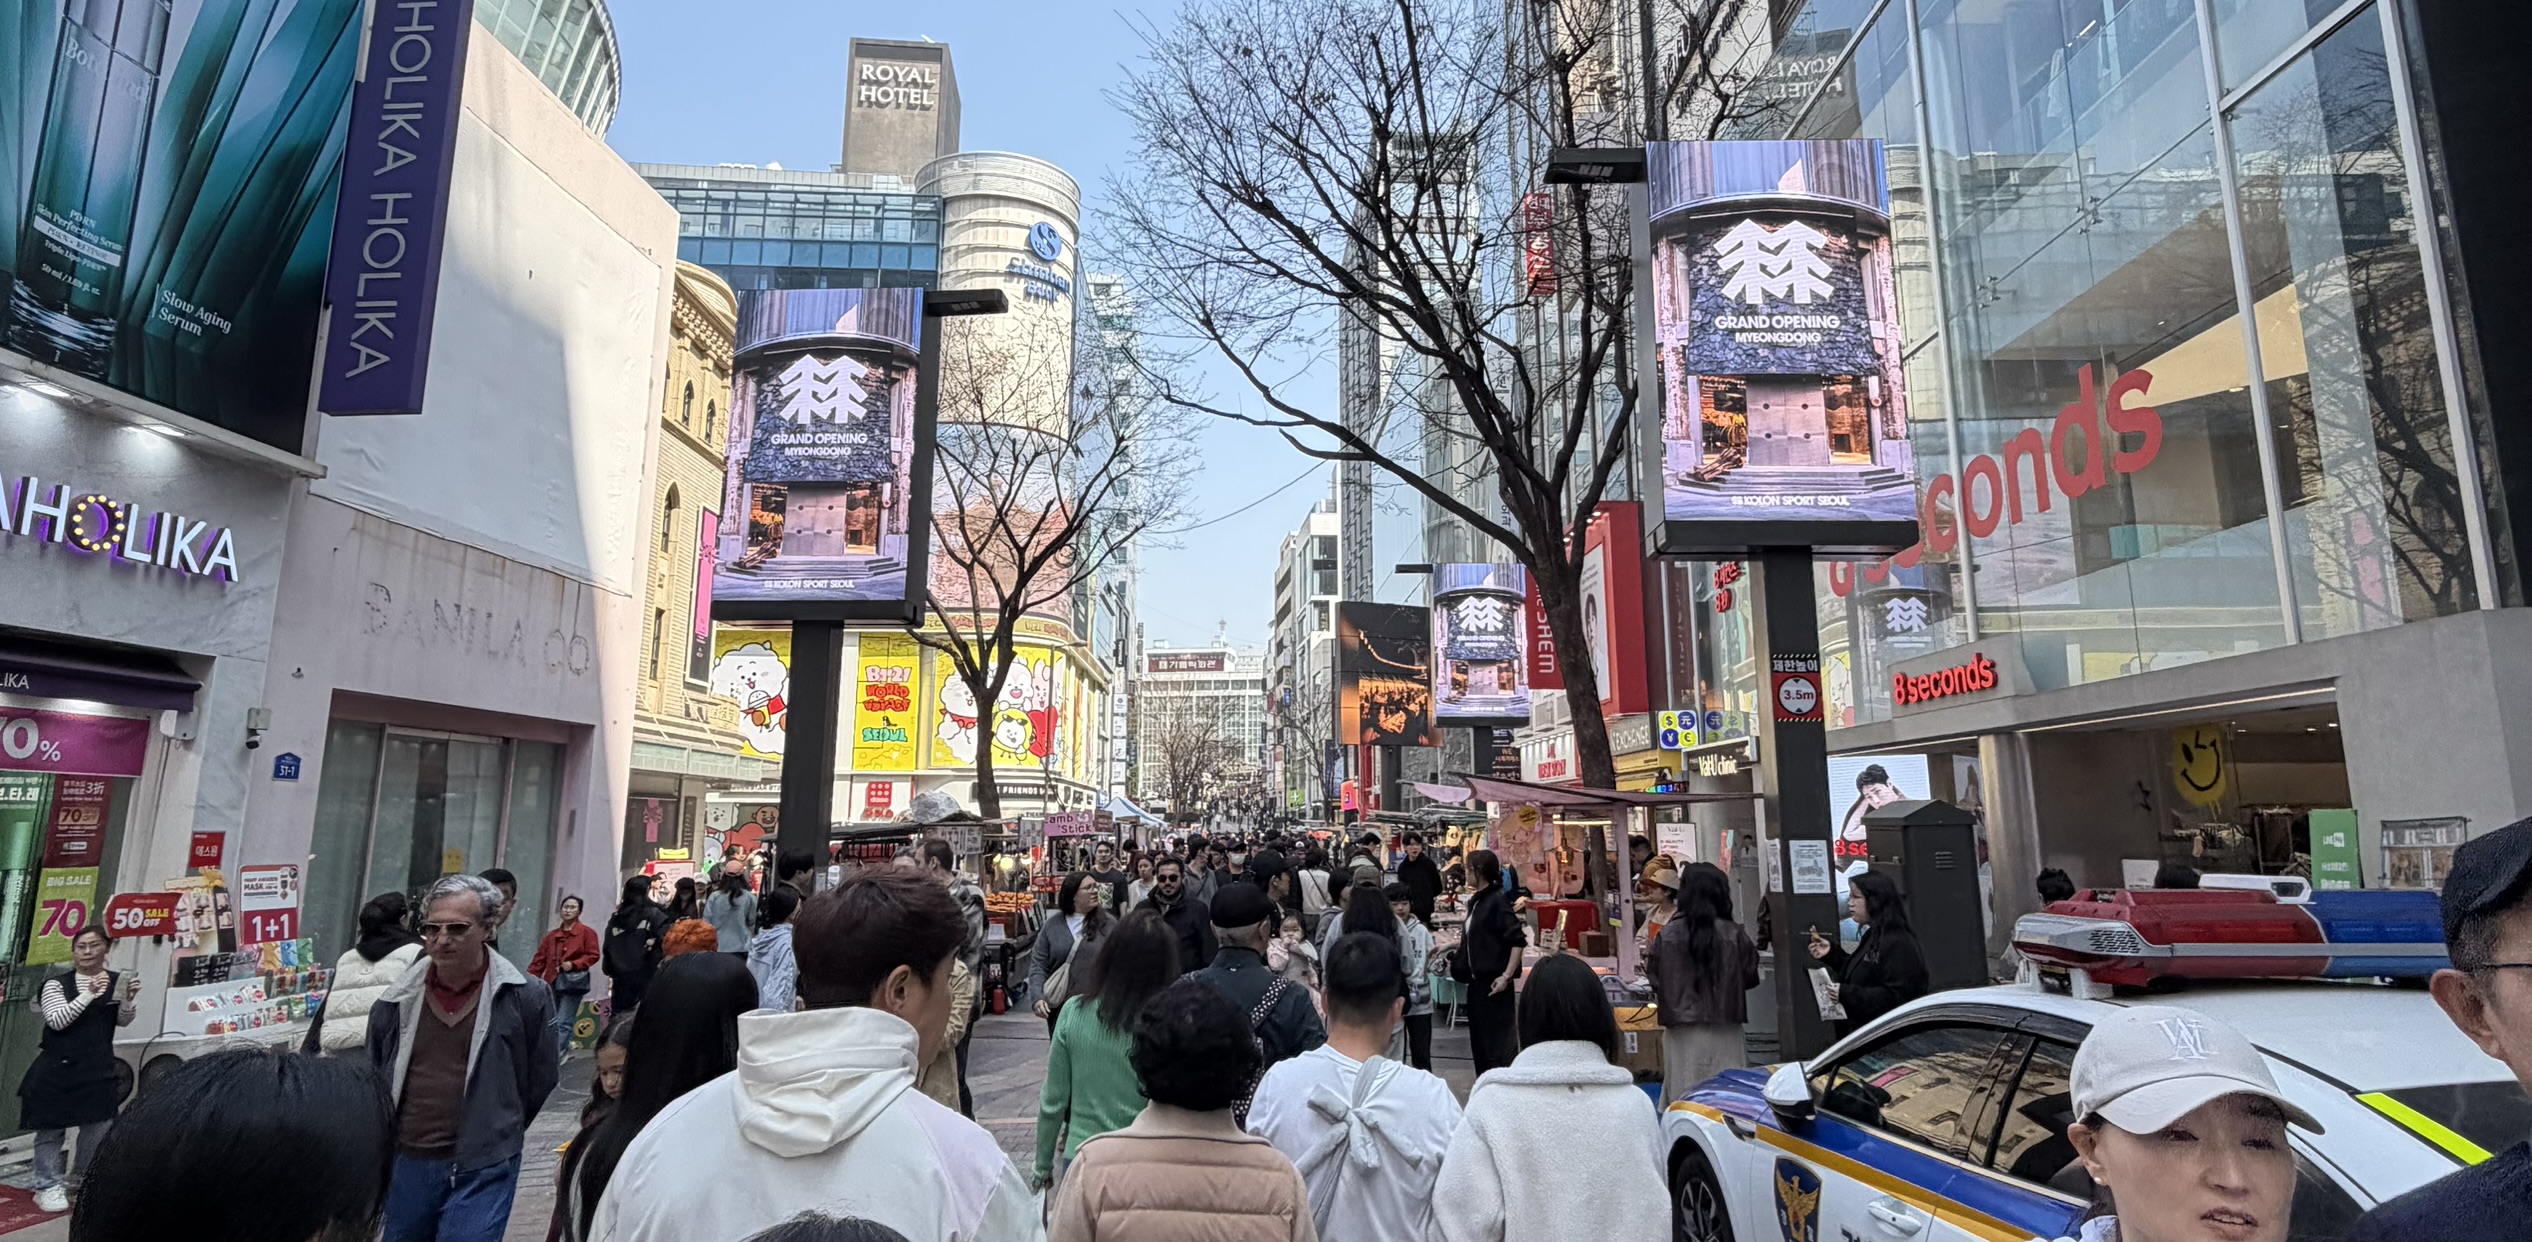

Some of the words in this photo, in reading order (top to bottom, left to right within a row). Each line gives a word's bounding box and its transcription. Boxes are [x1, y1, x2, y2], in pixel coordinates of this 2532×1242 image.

[862, 64, 936, 84] ROYAL
[373, 1, 438, 177] HOLIKA
[859, 86, 934, 106] HOTEL
[52, 212, 99, 244] Perfecting
[345, 192, 412, 379] HOLIKA
[161, 289, 194, 314] Slow
[194, 306, 232, 335] Aging
[158, 307, 202, 337] Serum
[1714, 315, 1770, 330] GRAND
[1771, 315, 1840, 330] OPENING
[1735, 332, 1821, 344] MYEONGDONG
[770, 433, 813, 445] GRAND
[814, 432, 868, 445] OPENING
[784, 447, 851, 456] MYEONGDONG
[1743, 495, 1781, 507] KOLON
[1782, 495, 1816, 506] SPORT
[1817, 495, 1850, 506] SEOUL
[802, 580, 828, 588] SPORT
[829, 580, 855, 588] SEOUL
[1773, 660, 1818, 672] 제한높이
[0, 672, 29, 689] IKA
[865, 683, 910, 698] WORLD
[1783, 689, 1814, 701] 3.5m
[861, 727, 908, 742] SEOUL
[1003, 786, 1038, 795] FRIENDS
[61, 809, 82, 823] 70
[46, 877, 65, 888] BIG
[66, 875, 92, 886] SALE
[244, 883, 264, 891] MASK
[38, 899, 87, 939] 70
[112, 907, 144, 930] 50
[144, 908, 169, 918] SALE
[143, 918, 160, 927] OFF
[252, 913, 289, 942] 1+1
